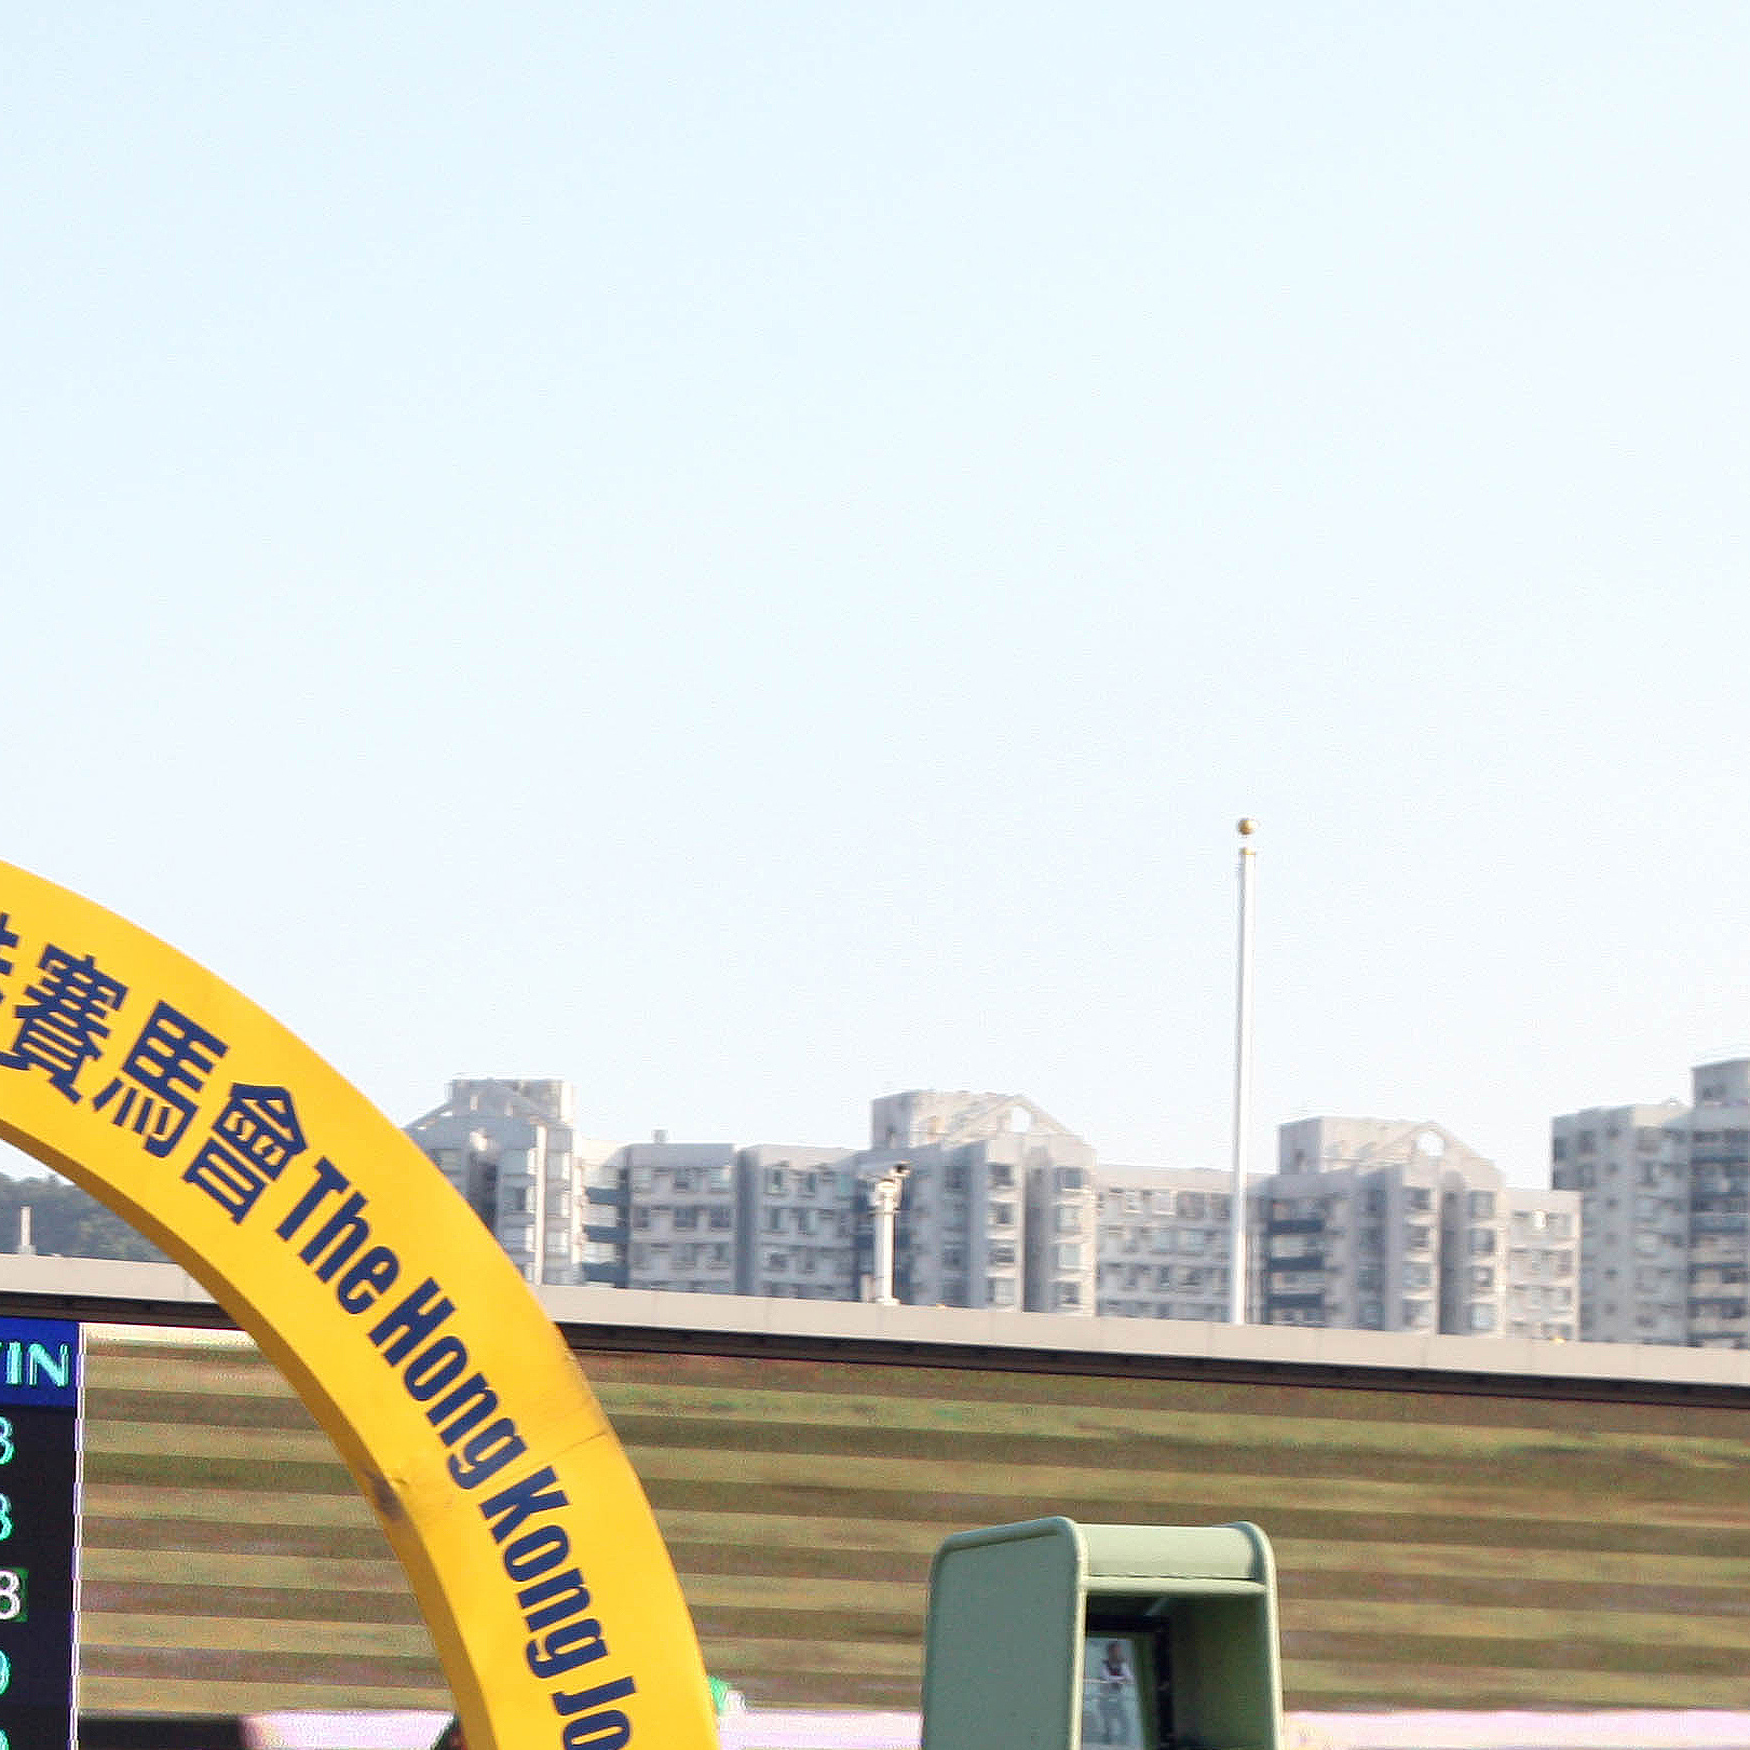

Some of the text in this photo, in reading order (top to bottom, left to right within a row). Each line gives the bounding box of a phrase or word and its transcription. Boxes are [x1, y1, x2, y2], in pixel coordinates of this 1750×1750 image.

[277, 1158, 399, 1315] The
[370, 1279, 526, 1489] Hong
[481, 1467, 607, 1679] Kong
